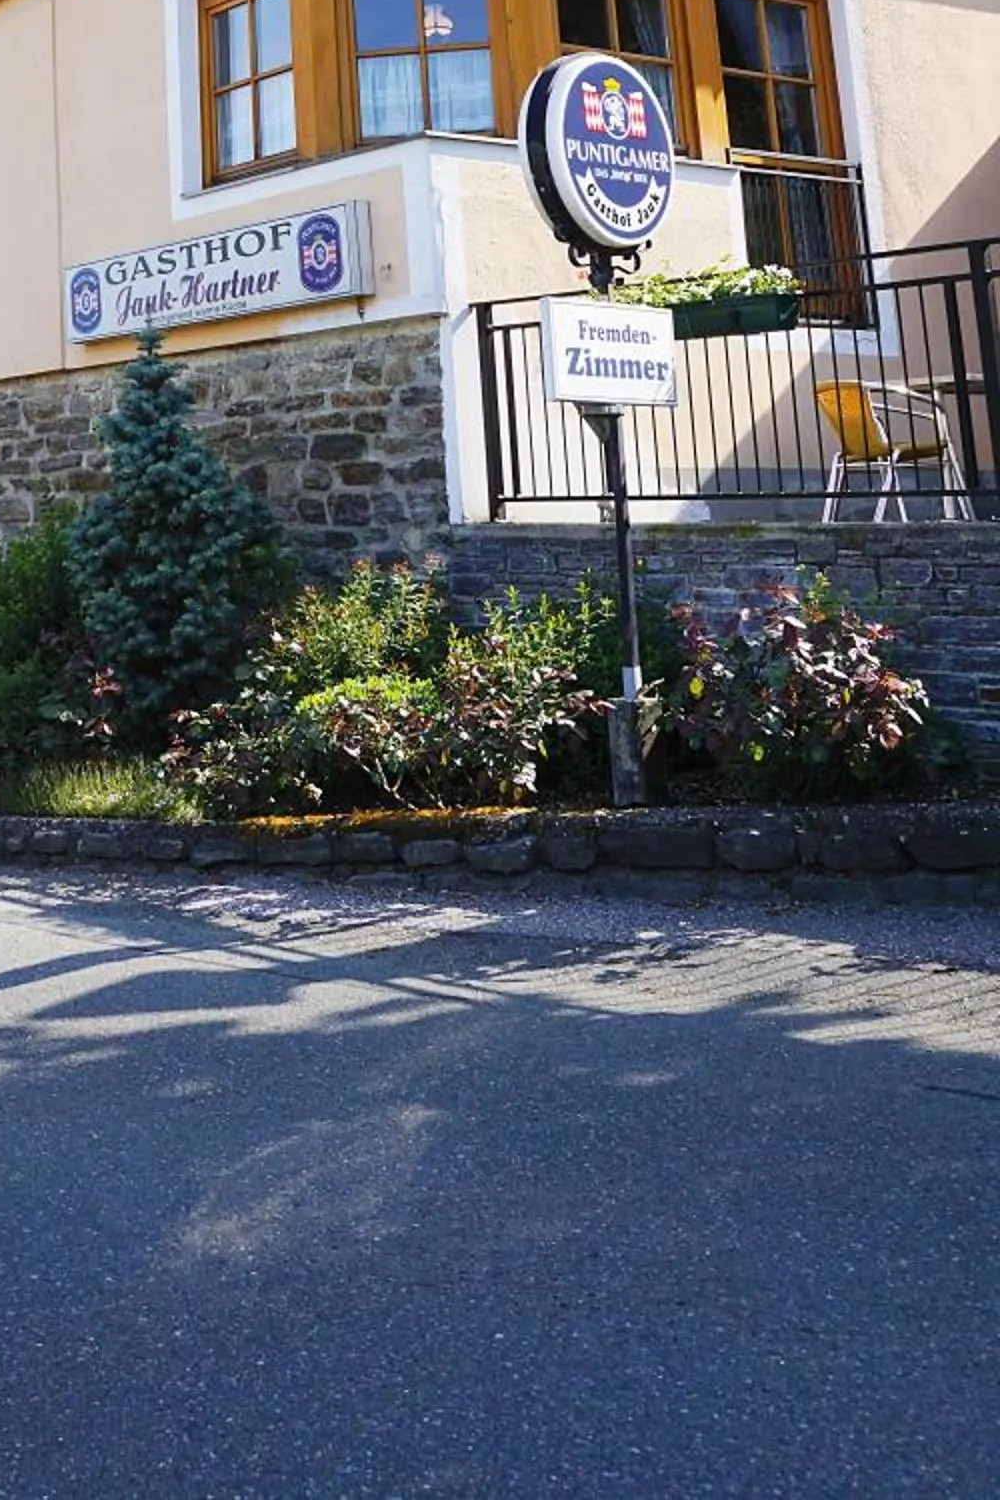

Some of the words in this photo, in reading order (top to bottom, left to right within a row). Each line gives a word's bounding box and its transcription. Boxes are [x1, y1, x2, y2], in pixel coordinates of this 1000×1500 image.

[566, 138, 669, 173] PUNTIGAMER
[104, 222, 293, 286] GASTHOF
[115, 267, 280, 326] Jauk-Hartner
[578, 319, 657, 344] Fremden-
[565, 347, 669, 381] Zimmer
